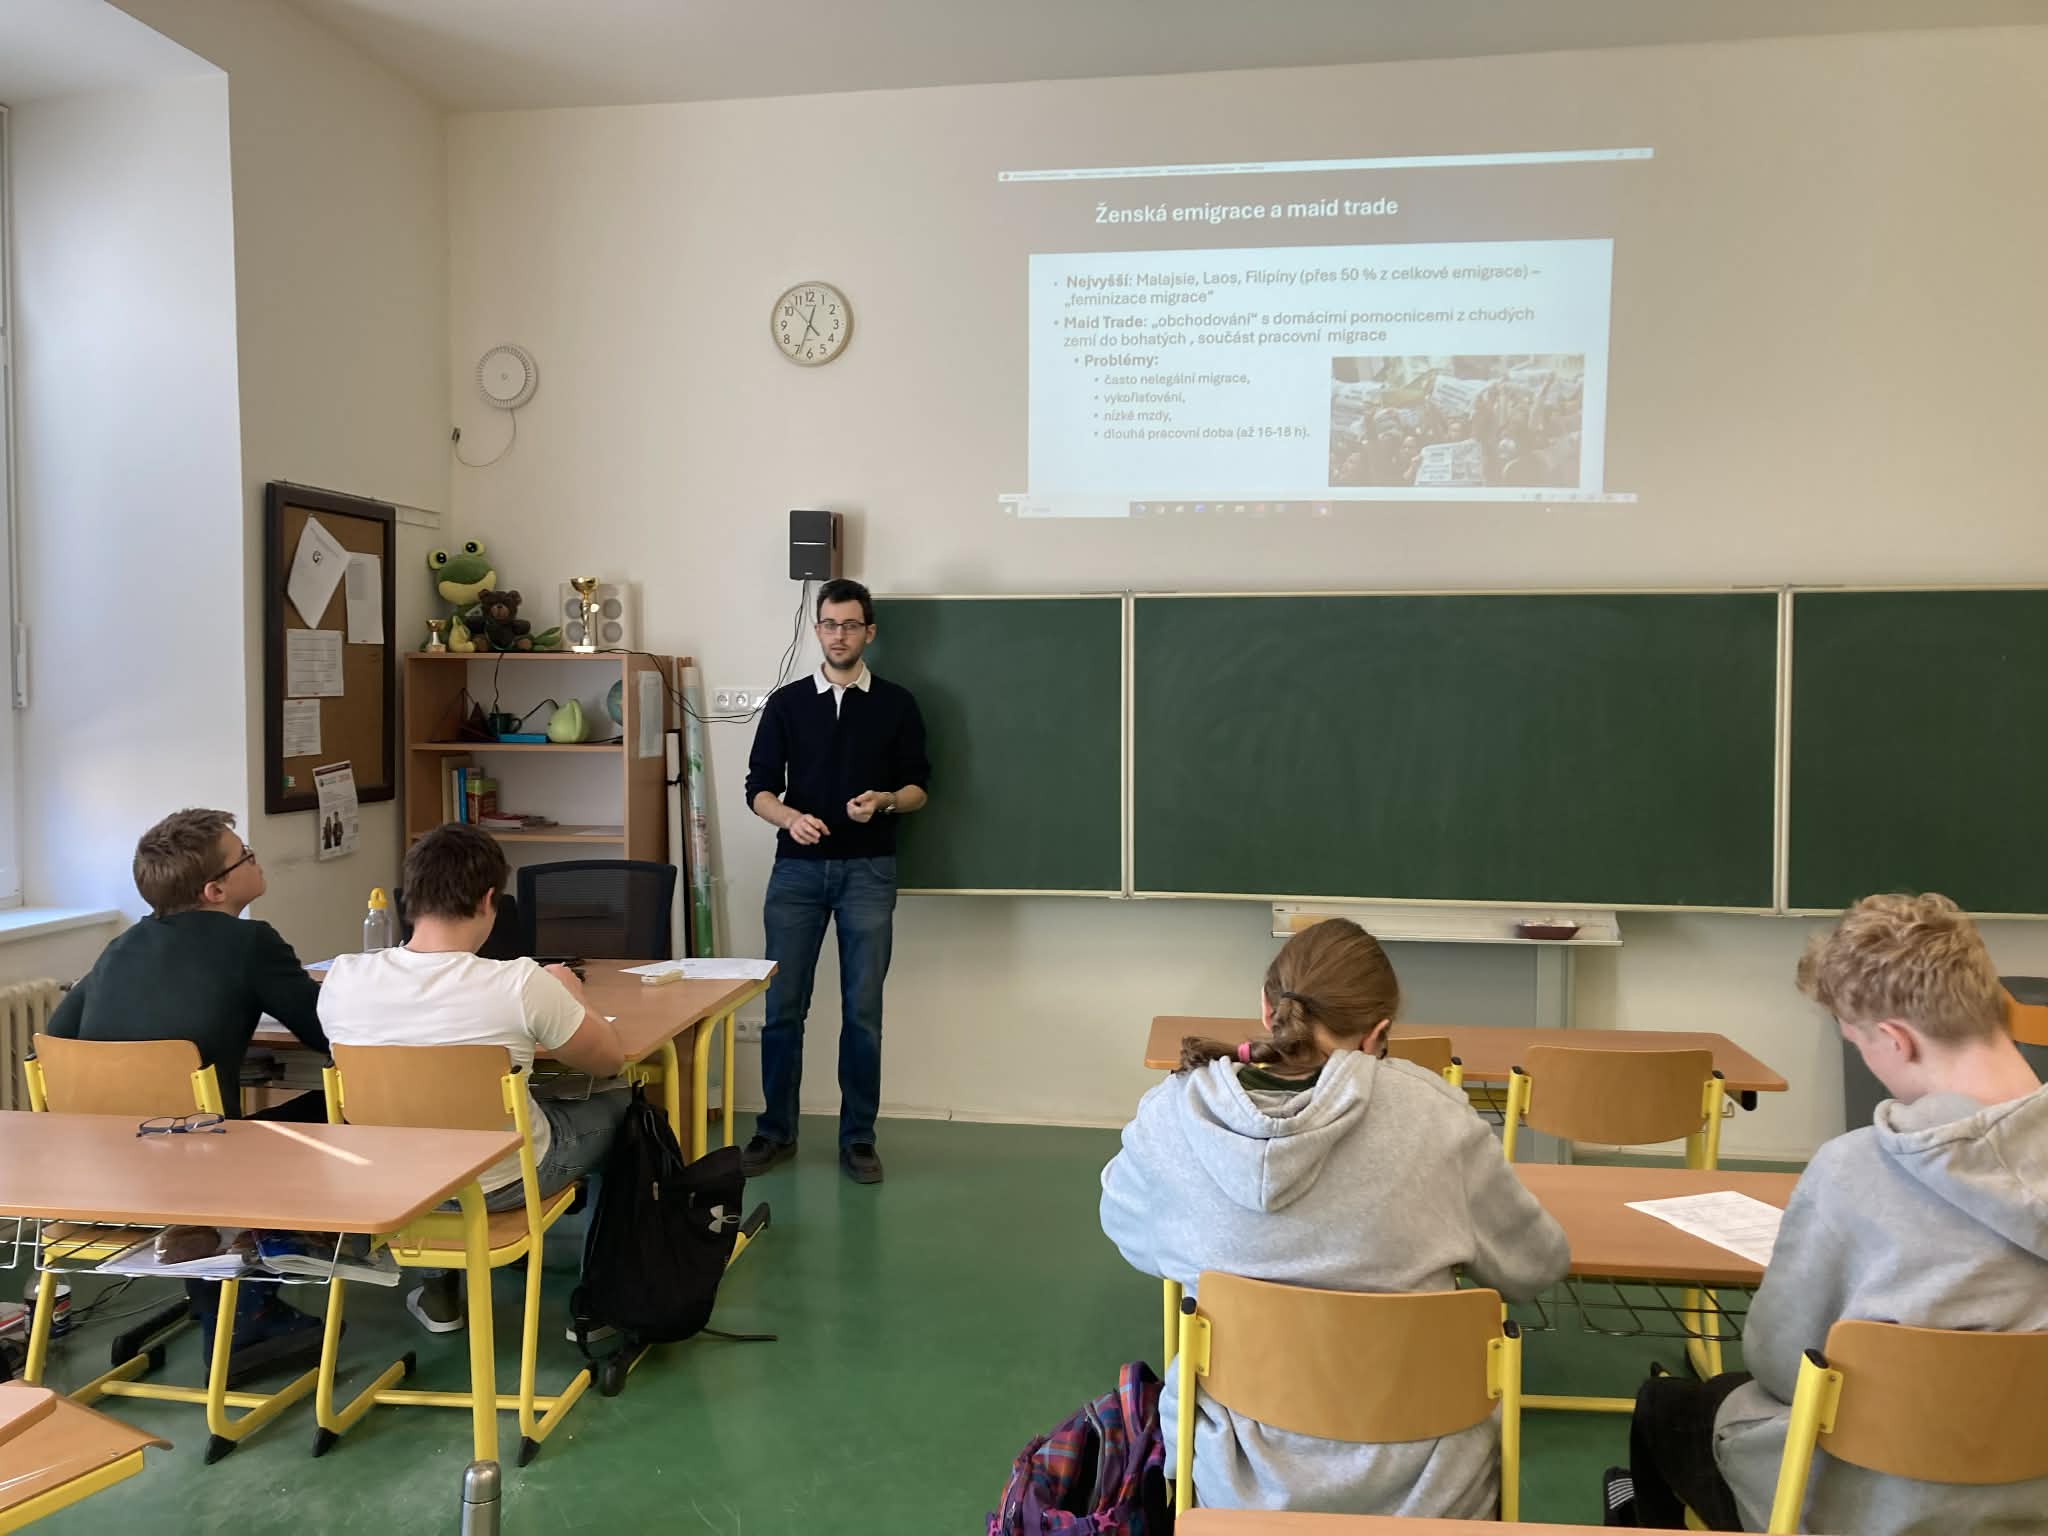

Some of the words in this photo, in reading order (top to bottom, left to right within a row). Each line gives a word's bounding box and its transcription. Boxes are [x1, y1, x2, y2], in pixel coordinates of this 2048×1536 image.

[1095, 202, 1168, 224] Ženská
[1172, 202, 1265, 224] emigrace
[1270, 205, 1282, 218] a
[1287, 200, 1339, 217] maid
[1343, 198, 1399, 216] trade
[1066, 273, 1133, 290] Nejvyšší:
[1136, 271, 1199, 288] Malajsie,
[1203, 271, 1242, 286] Laos,
[1300, 268, 1337, 285] (přes
[1340, 268, 1359, 281] 50
[1363, 267, 1377, 281] %
[1380, 271, 1388, 281] z
[1391, 265, 1449, 280] celkové
[1452, 264, 1528, 280] emigrace)
[795, 295, 802, 305] 11
[805, 291, 815, 302] 12
[821, 294, 825, 305] 1
[784, 306, 793, 316] 10
[829, 304, 836, 315] 2
[1064, 316, 1100, 329] Maid
[1103, 315, 1147, 329] Trade:
[1261, 315, 1269, 326] s
[1350, 308, 1454, 325] pomocnicemi
[1457, 312, 1465, 322] z
[1468, 307, 1535, 324] chudých
[781, 320, 787, 331] 9
[833, 319, 839, 329] 3
[784, 334, 790, 344] 8
[828, 333, 834, 342] 4
[1063, 333, 1096, 347] zemí
[1099, 332, 1118, 346] do
[1121, 331, 1186, 347] bohatých
[1198, 330, 1255, 345] součást
[1258, 328, 1320, 346] pracovní
[1327, 327, 1387, 345] migrace
[794, 344, 800, 354] 7
[806, 348, 813, 360] 6
[820, 344, 826, 354] 5
[1084, 353, 1159, 368] Problémy:
[1103, 374, 1137, 386] často
[1140, 373, 1196, 386] nelegální
[1198, 372, 1251, 386] migrace,
[1137, 411, 1173, 423] mzdy,
[1103, 427, 1145, 440] dlouhá
[1147, 425, 1200, 440] pracovní
[1202, 425, 1234, 438] doba
[1236, 425, 1255, 440] (až
[1258, 425, 1292, 438] 16-18
[1294, 425, 1311, 439] h).
